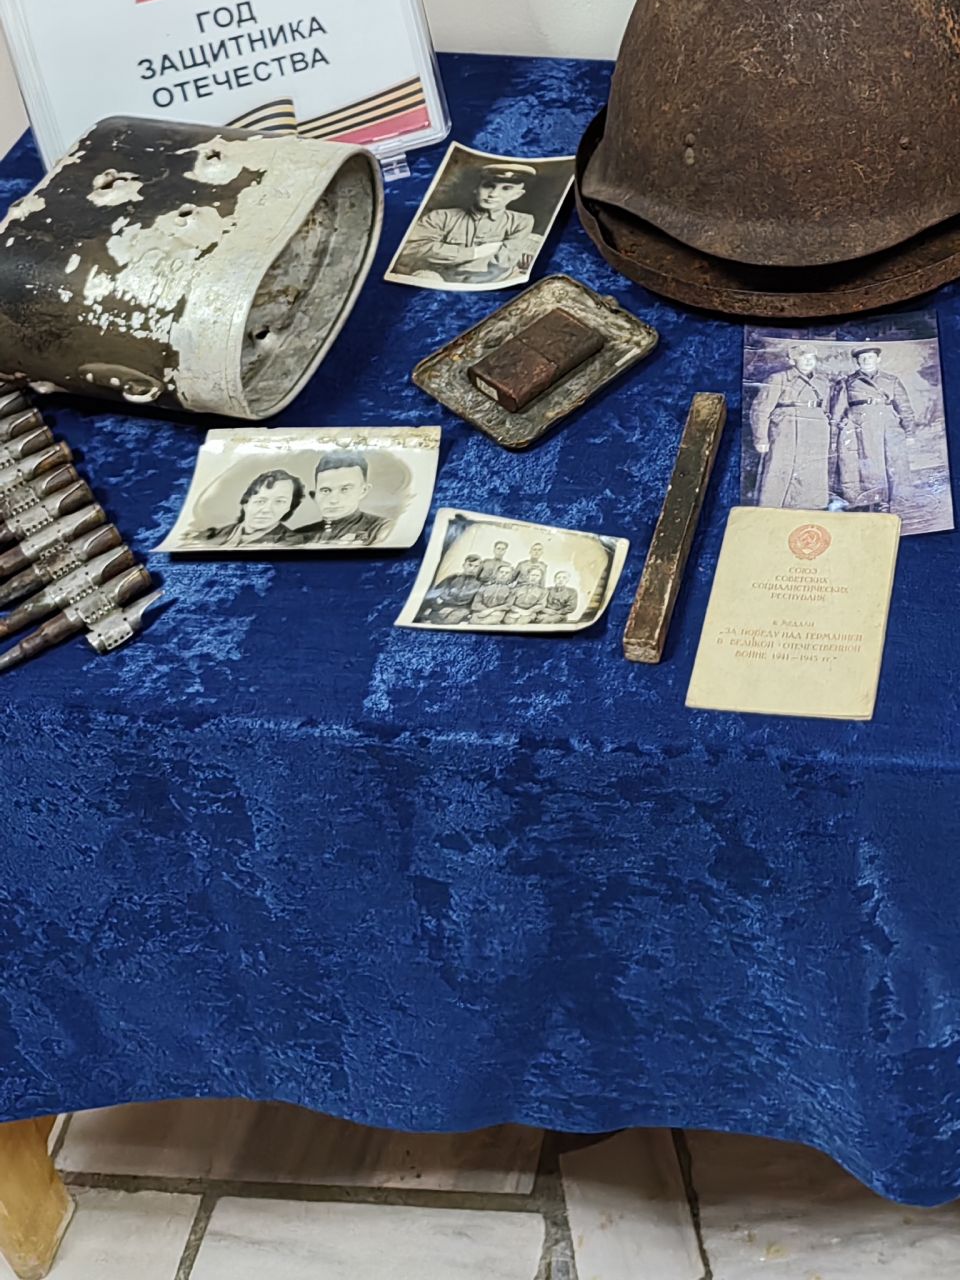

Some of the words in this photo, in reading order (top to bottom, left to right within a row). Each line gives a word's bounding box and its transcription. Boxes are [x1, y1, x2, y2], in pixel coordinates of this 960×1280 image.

[196, 1, 257, 33] ГОД
[136, 16, 328, 80] ЗАЩИТНИКА
[152, 47, 330, 107] ОТЕЧЕСТВА
